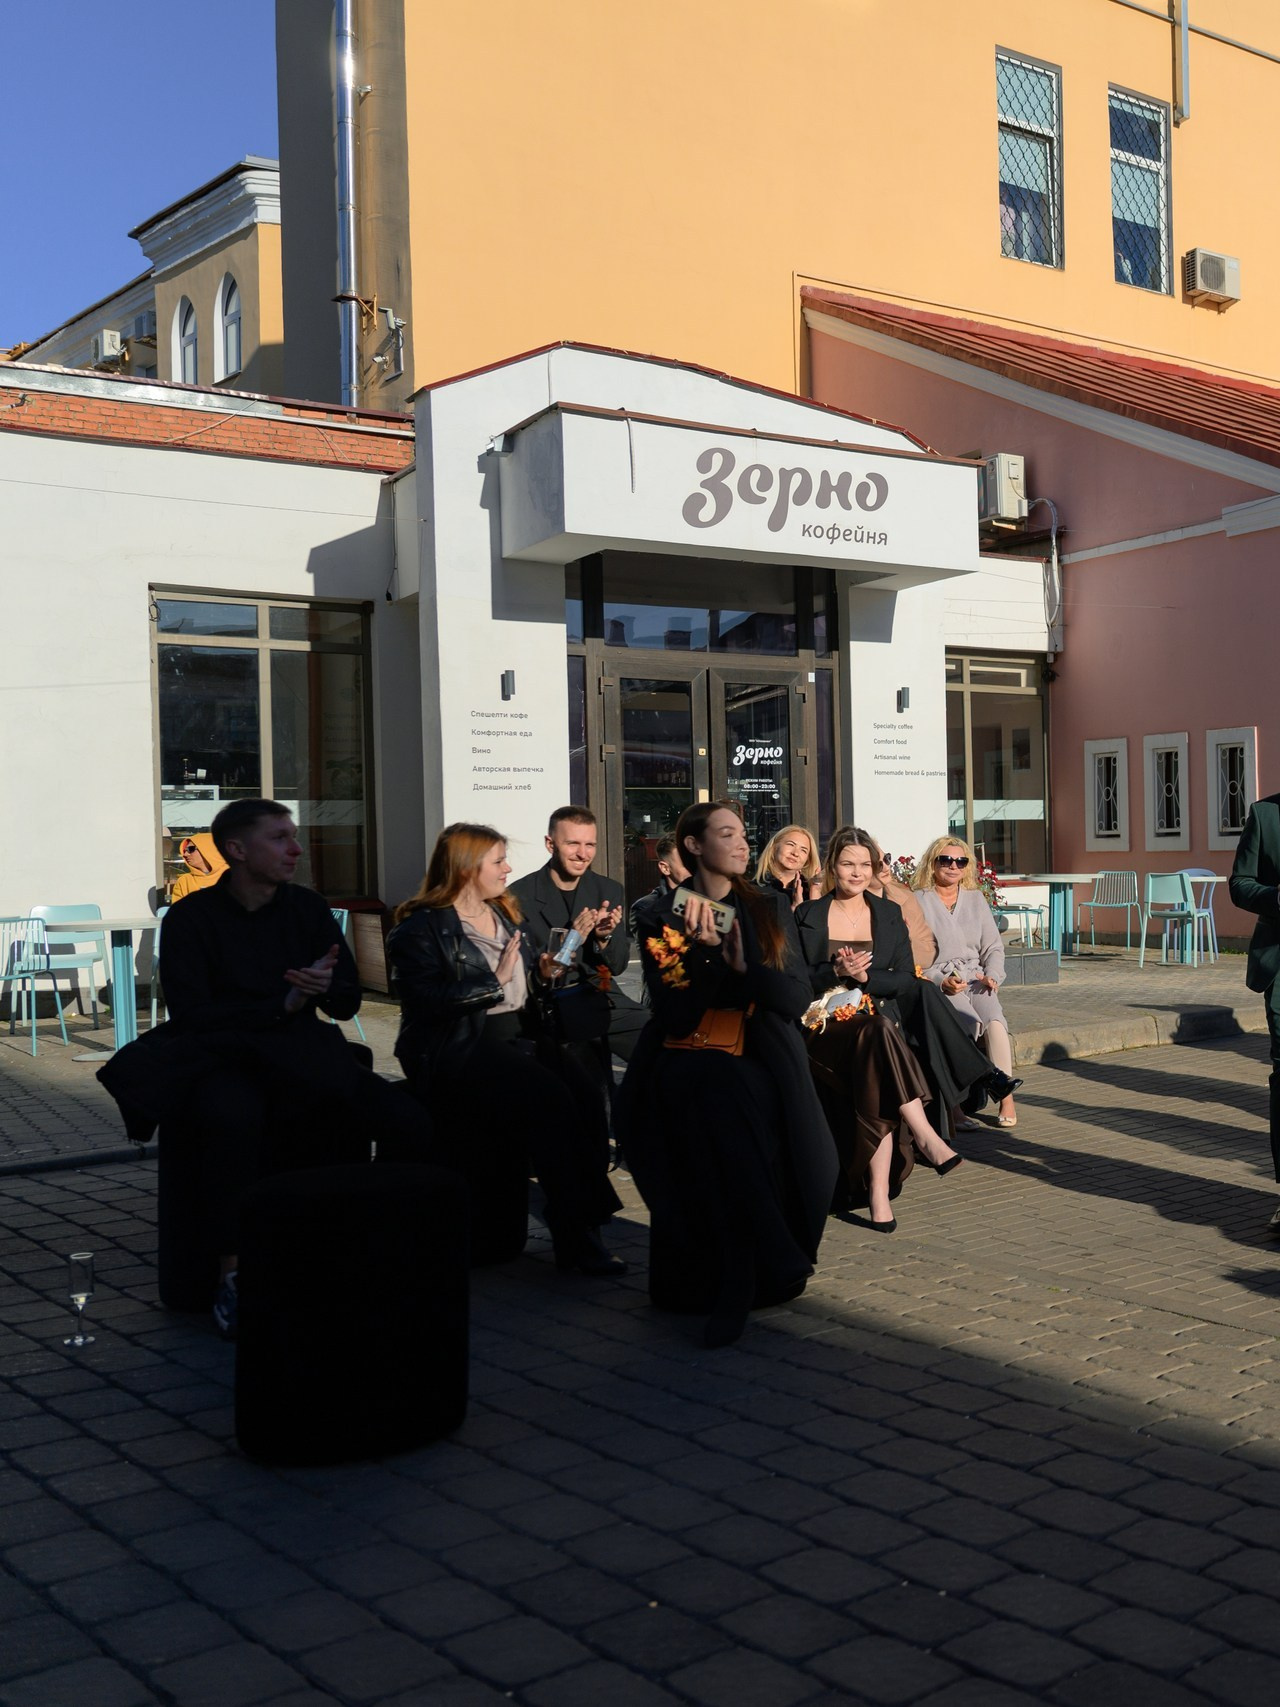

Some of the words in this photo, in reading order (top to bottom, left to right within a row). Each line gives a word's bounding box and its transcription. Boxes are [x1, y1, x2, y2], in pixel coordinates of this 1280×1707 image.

[681, 446, 889, 533] Зерно
[801, 522, 889, 546] кофейня
[470, 710, 508, 719] Спешелти
[510, 711, 529, 719] кофе
[873, 722, 897, 730] Specialty
[471, 728, 518, 738] Комфортная
[519, 730, 533, 738] еда
[471, 746, 492, 754] Вино
[732, 744, 784, 766] Зерно
[760, 758, 783, 766] кофейня
[472, 765, 511, 774] Авторская
[512, 766, 544, 774] выпечка
[874, 769, 904, 777] Homemade
[905, 769, 920, 777] bread
[472, 783, 513, 792] Домашний
[514, 783, 532, 792] хлеб
